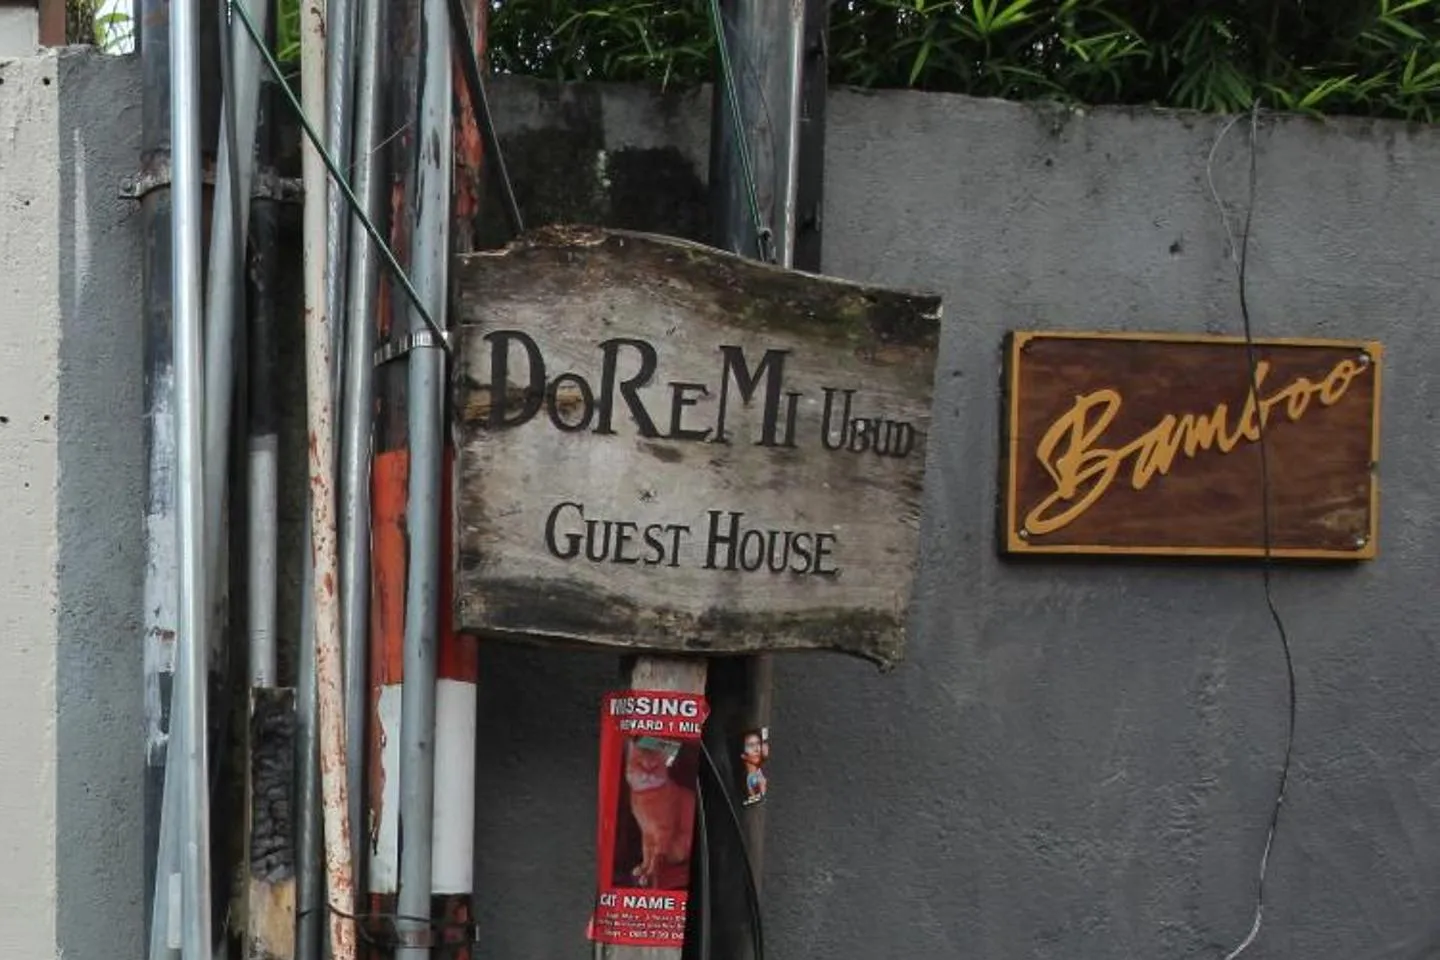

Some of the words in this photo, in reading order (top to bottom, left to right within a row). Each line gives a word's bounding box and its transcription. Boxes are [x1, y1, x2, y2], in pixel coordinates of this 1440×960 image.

[1024, 358, 1365, 535] Bamboo
[544, 502, 689, 568] GUEST
[702, 510, 842, 576] HOUSE
[610, 697, 698, 717] MISSING
[623, 896, 675, 910] NAME
